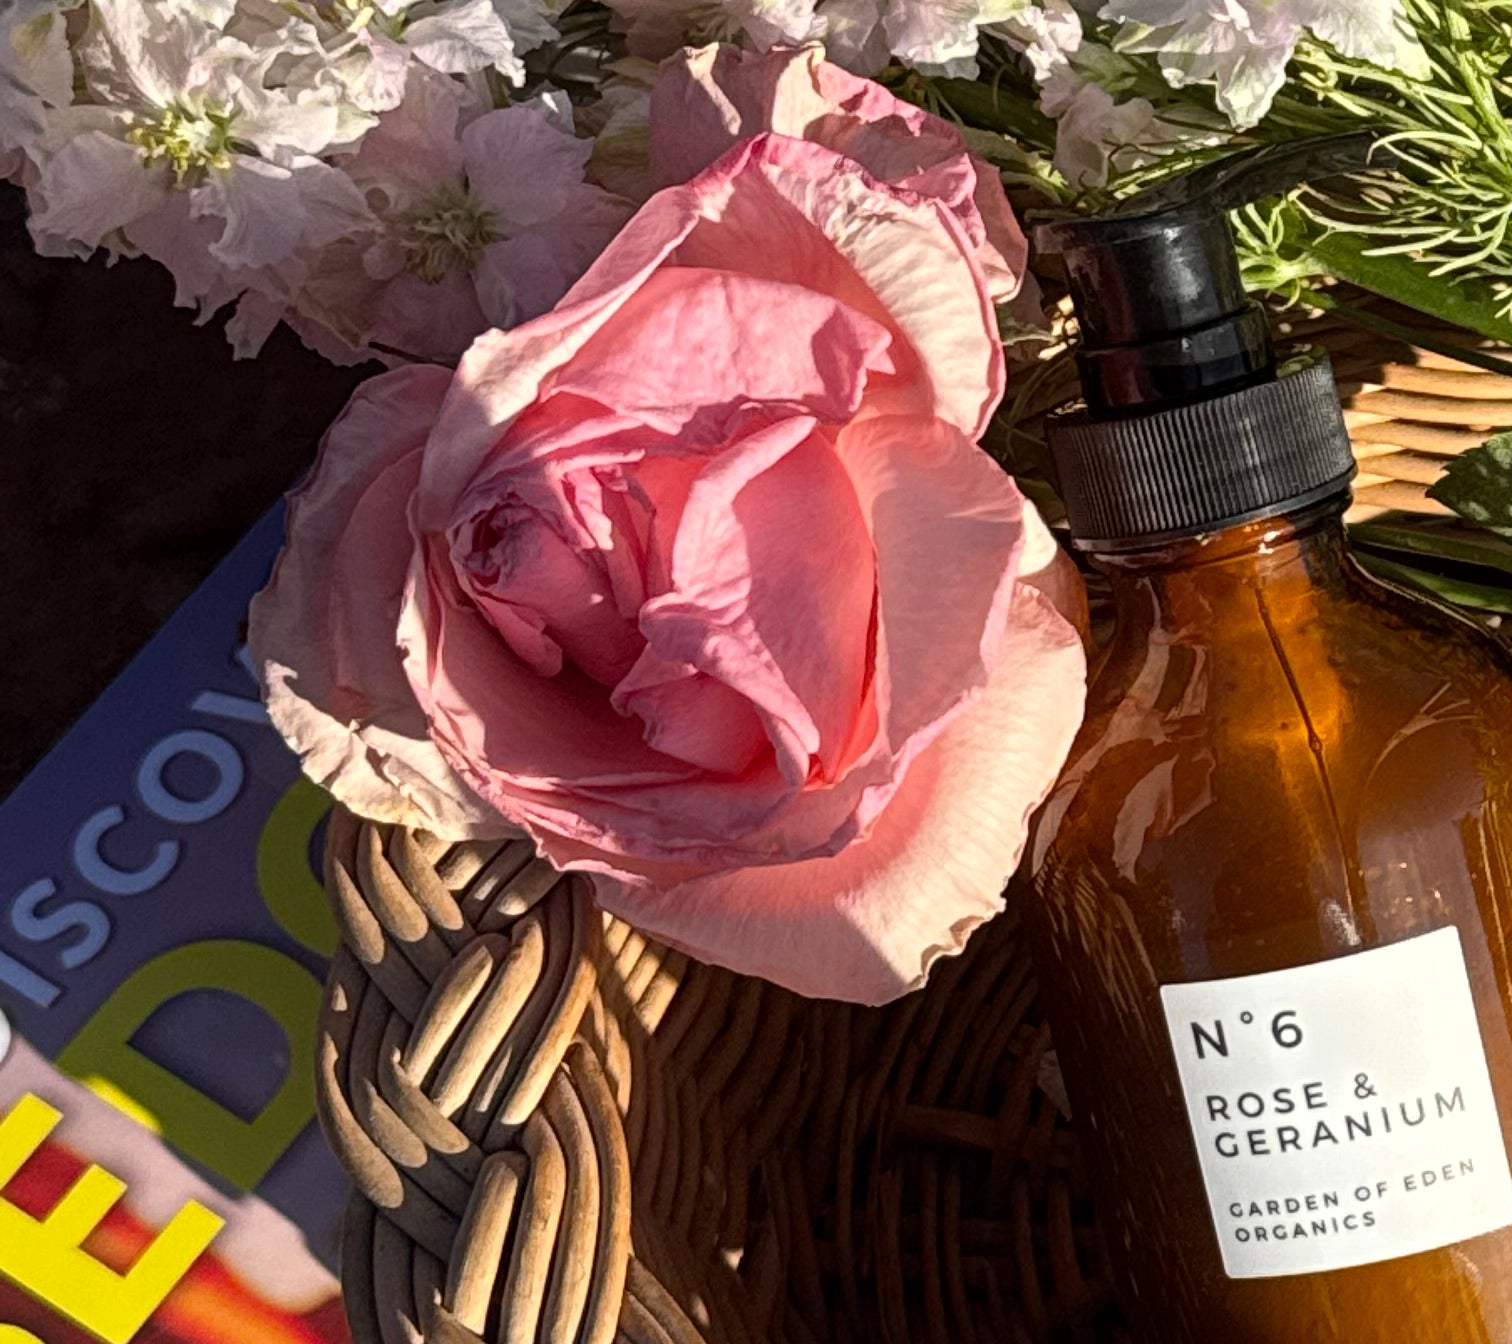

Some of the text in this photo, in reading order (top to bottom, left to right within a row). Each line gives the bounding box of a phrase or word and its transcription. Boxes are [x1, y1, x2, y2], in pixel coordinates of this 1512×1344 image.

[1206, 1072, 1378, 1122] ROSE &
[1214, 1086, 1467, 1158] GERANIUM
[1229, 1158, 1477, 1219] GARDEN OF EDEN
[1234, 1211, 1377, 1243] ORGANICS
